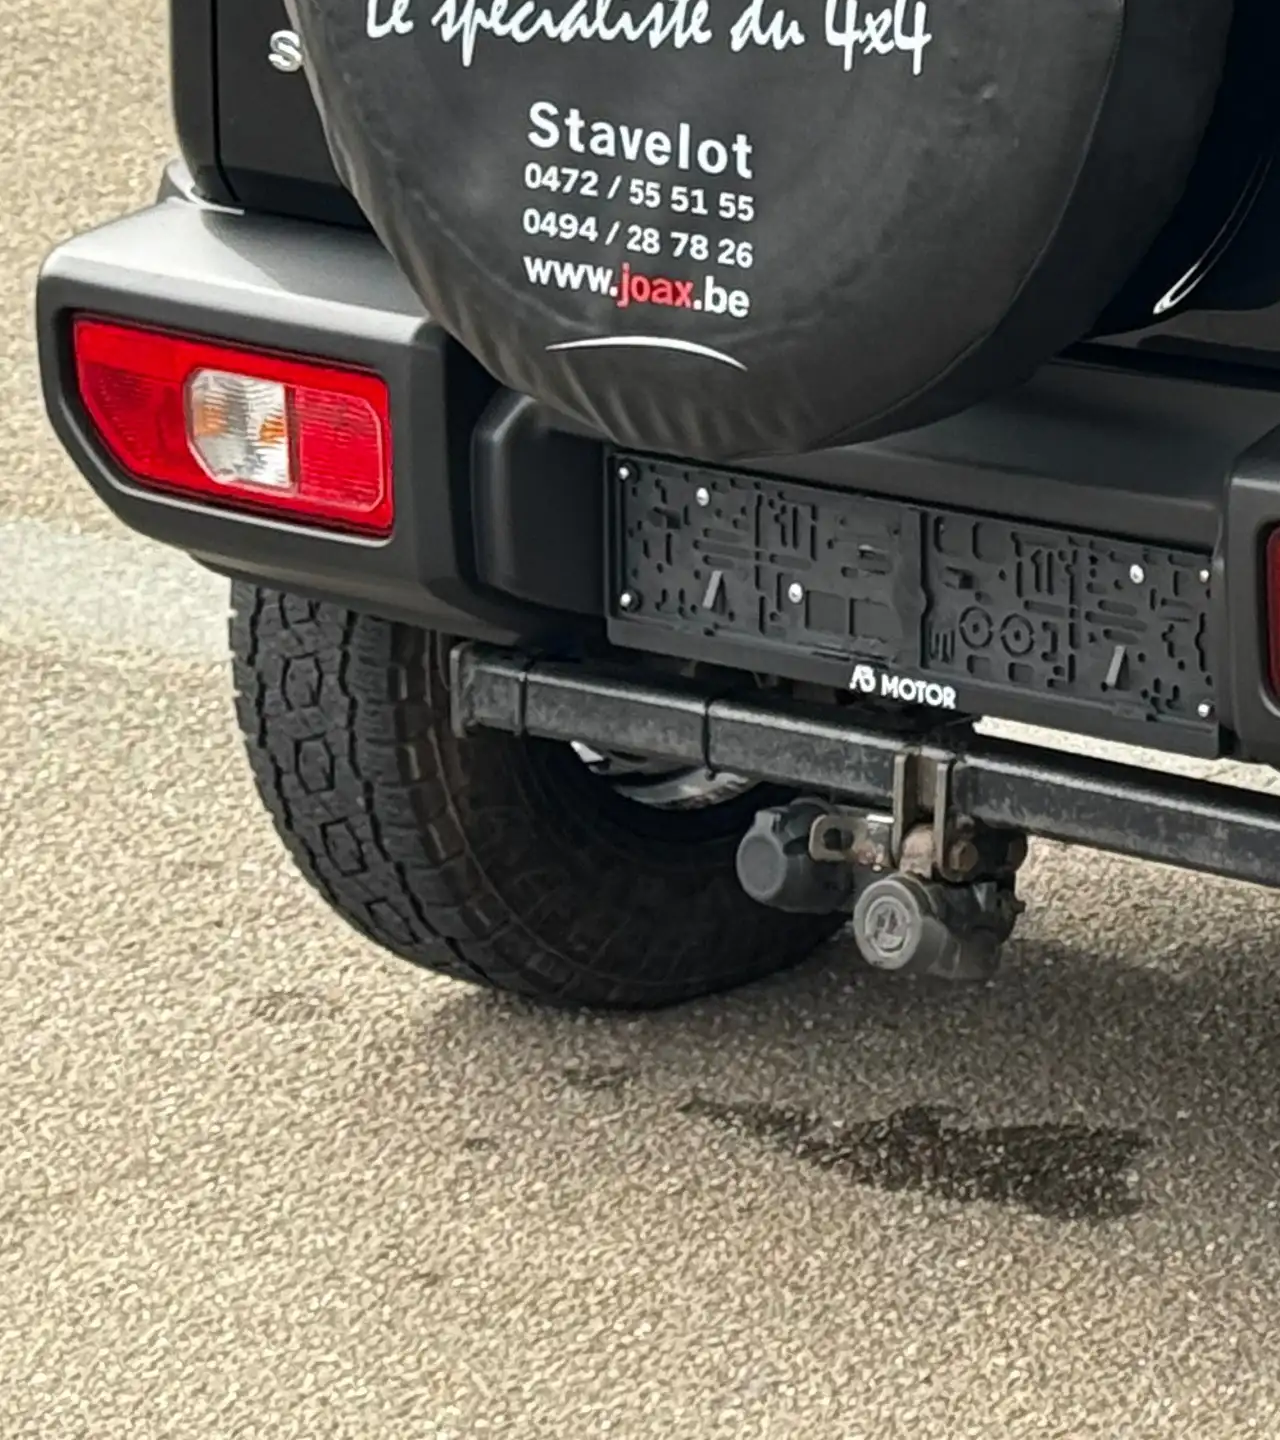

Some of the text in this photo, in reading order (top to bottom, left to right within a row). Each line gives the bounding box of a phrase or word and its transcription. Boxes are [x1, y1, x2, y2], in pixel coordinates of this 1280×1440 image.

[527, 101, 753, 180] Stavelot
[524, 162, 755, 222] 0472 / 55 51 55
[522, 207, 754, 269] 0494 / 28 78 26
[523, 255, 750, 318] www.joax.be
[880, 673, 957, 710] MOTOR
